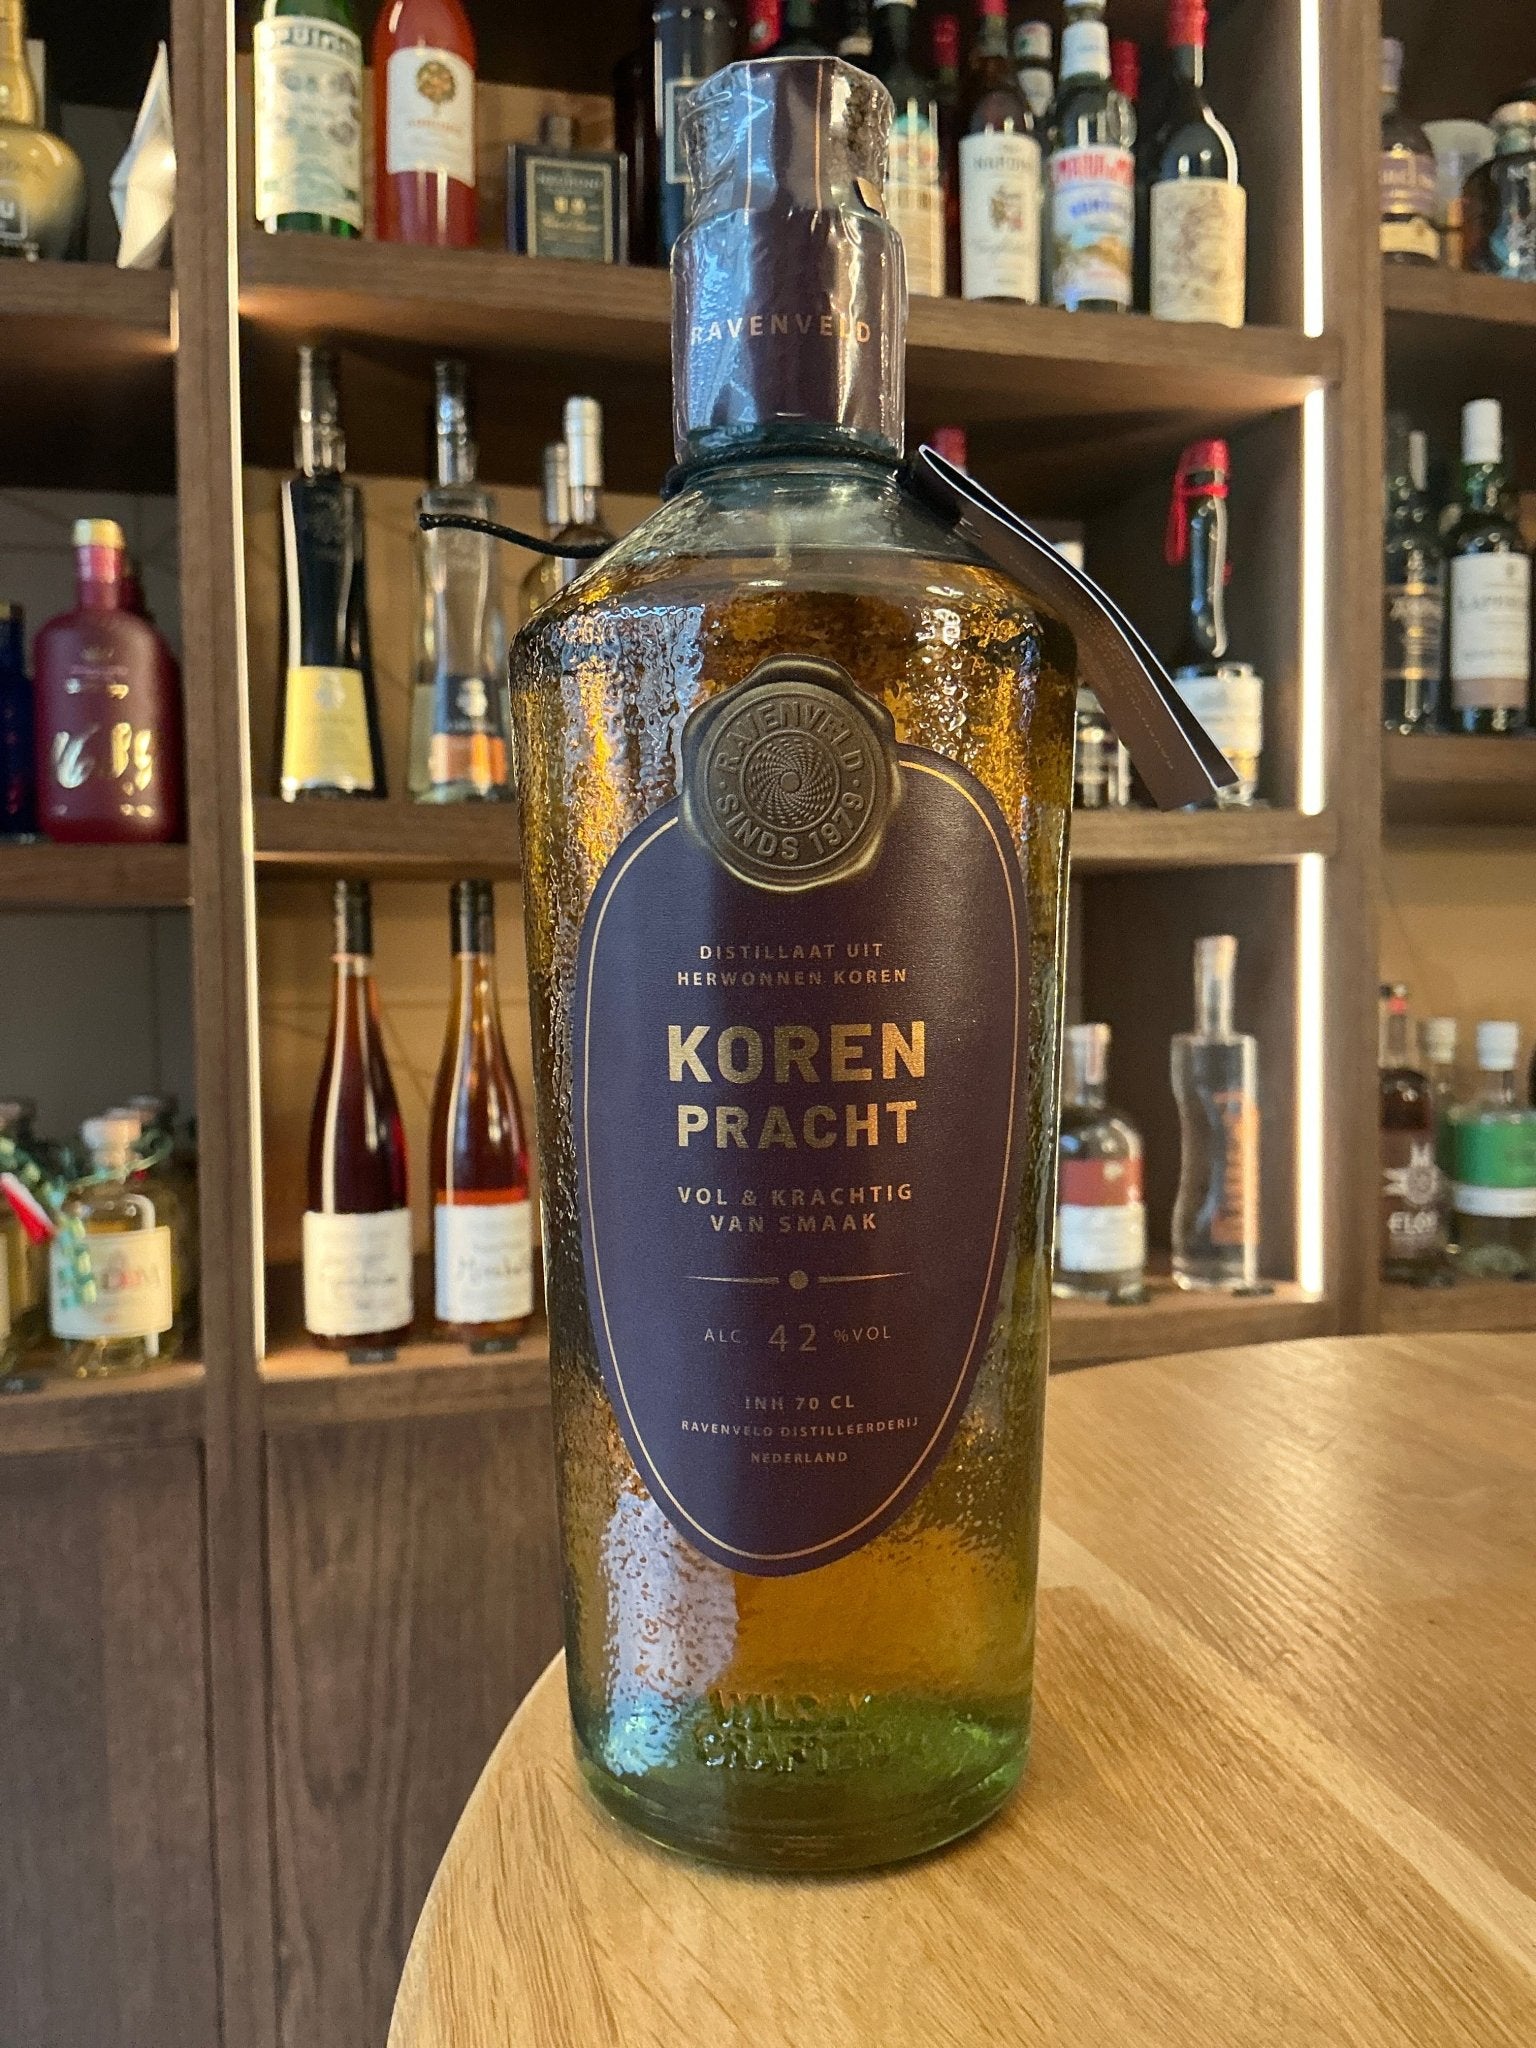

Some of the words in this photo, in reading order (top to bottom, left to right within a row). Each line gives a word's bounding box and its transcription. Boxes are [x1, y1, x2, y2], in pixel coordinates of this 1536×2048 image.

[690, 313, 872, 346] RAVENVELD
[716, 792, 801, 862] SINDS
[807, 792, 865, 855] 1979
[699, 944, 835, 961] DISTILLAAT
[846, 943, 885, 960] UIT
[676, 970, 823, 987] HERWONNEN
[832, 968, 908, 986] KOREN
[667, 1019, 927, 1084] KOREN
[677, 1100, 918, 1149] PRACHT
[677, 1186, 728, 1206] VOL
[742, 1188, 757, 1207] &
[771, 1183, 914, 1207] KRACHTIG
[710, 1214, 765, 1234] VAN
[778, 1212, 878, 1233] SMAAK
[744, 1396, 785, 1411] INH
[794, 1396, 820, 1411] 70
[829, 1394, 856, 1410] CL
[681, 1419, 774, 1437] RAVENVELD
[780, 1416, 920, 1437] DISTILLEERDERIJ
[750, 1450, 849, 1465] NEDERLAND
